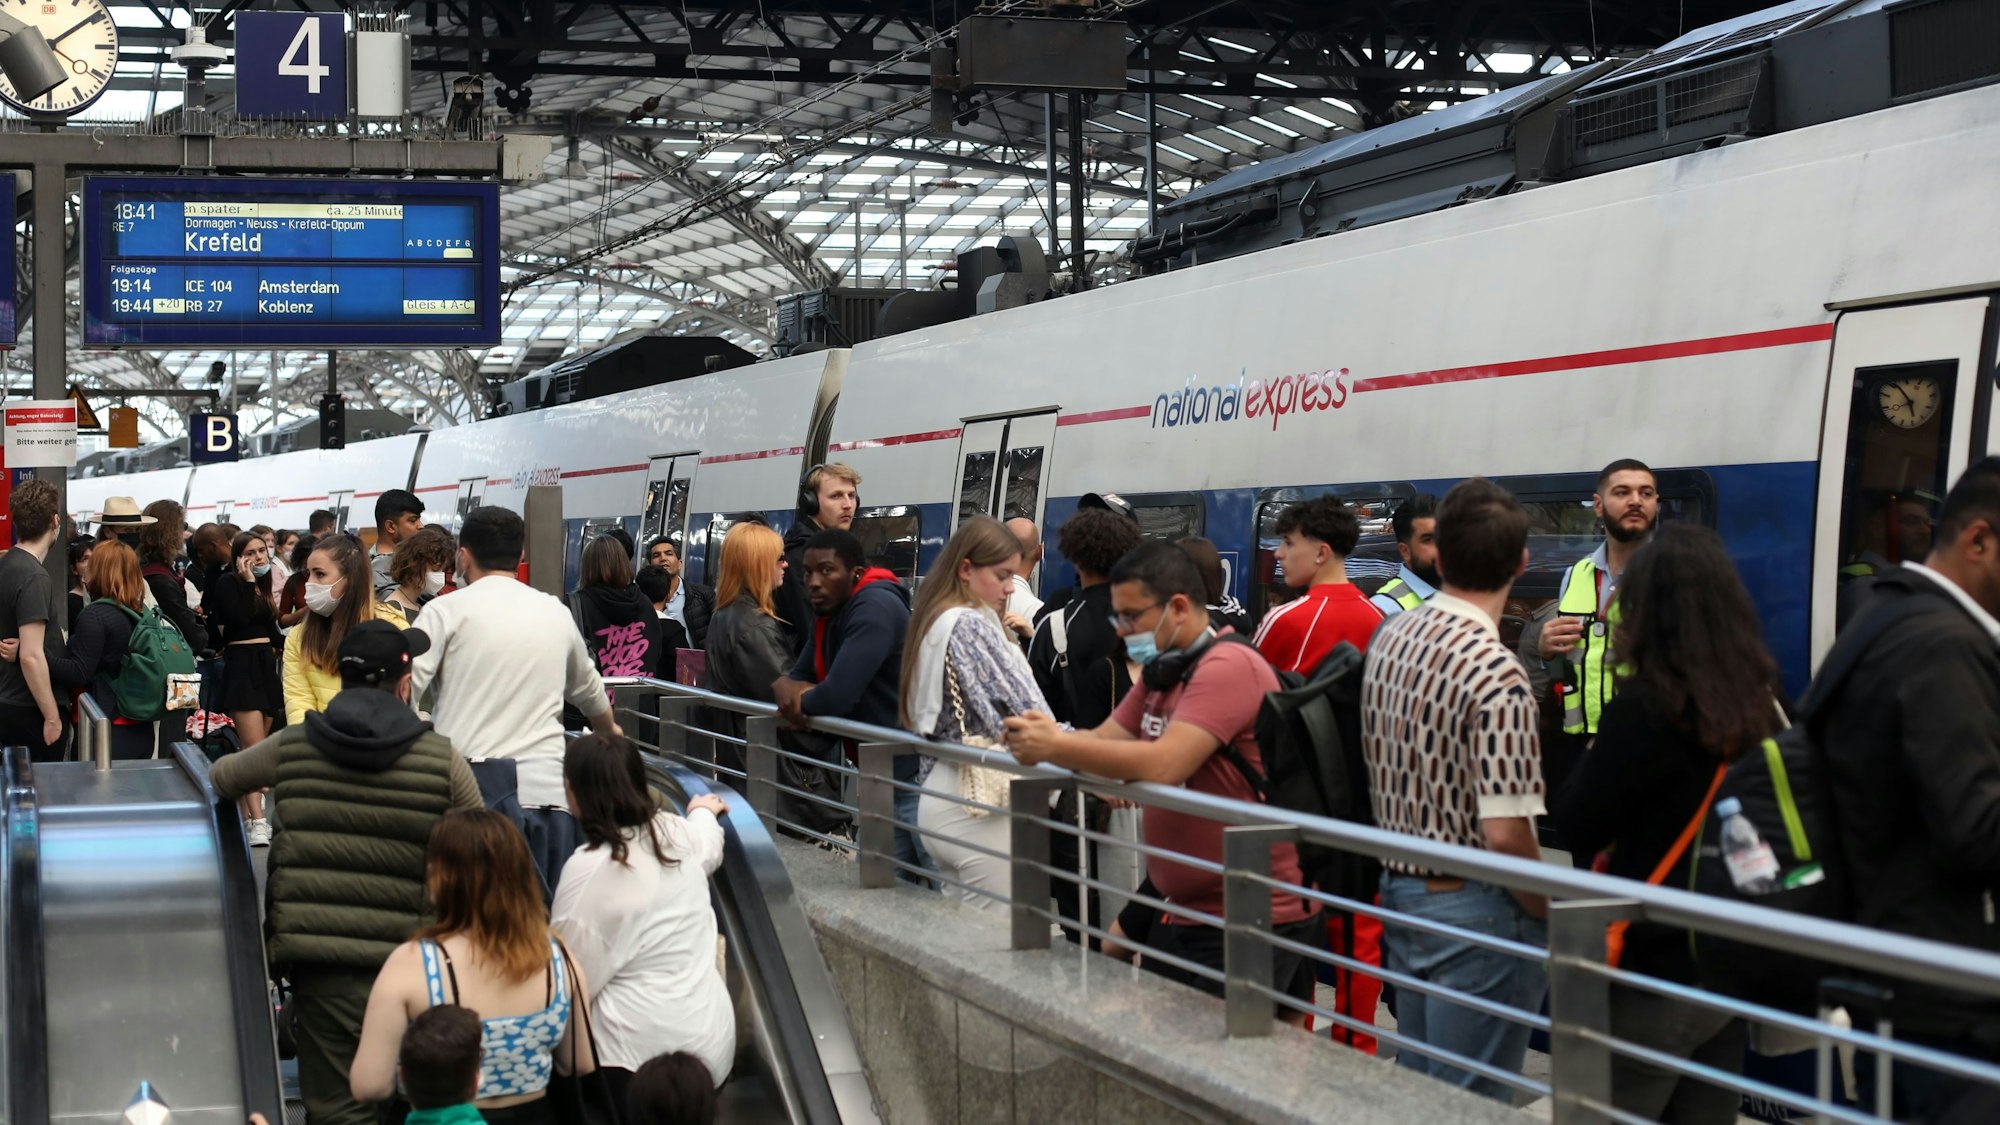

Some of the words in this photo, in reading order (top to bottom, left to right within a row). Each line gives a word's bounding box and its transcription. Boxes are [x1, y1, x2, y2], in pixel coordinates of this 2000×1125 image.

[278, 16, 330, 94] 4
[113, 203, 155, 220] 18:41
[326, 206, 344, 216] ca.
[348, 206, 361, 216] 25
[112, 222, 125, 232] RE
[128, 222, 134, 232] 7
[185, 217, 236, 231] Dormagen
[246, 218, 278, 229] Neuss
[288, 219, 365, 232] Krefeld-Oppum
[185, 232, 261, 252] Krefeld
[407, 239, 414, 247] A
[417, 239, 423, 247] B
[427, 239, 432, 247] C
[436, 239, 442, 247] D
[446, 239, 451, 247] E
[456, 239, 461, 247] F
[465, 239, 471, 247] G
[110, 265, 157, 275] Folgezüge
[112, 279, 151, 292] 19:14
[185, 280, 205, 292] ICE
[210, 280, 233, 292] 104
[258, 280, 340, 294] Amsterdam
[112, 299, 151, 313] 19:44
[158, 298, 180, 309] +20
[186, 301, 203, 312] RB
[207, 300, 223, 313] 27
[258, 299, 314, 314] Koblenz
[407, 300, 436, 310] Gleis
[440, 300, 446, 310] 4
[450, 300, 471, 310] A-C
[1152, 366, 1246, 429] national
[1244, 366, 1350, 432] express
[16, 438, 35, 446] Bitte
[37, 438, 62, 446] weiter
[207, 416, 233, 452] B
[595, 621, 646, 650] THE
[598, 638, 650, 668] GOOD
